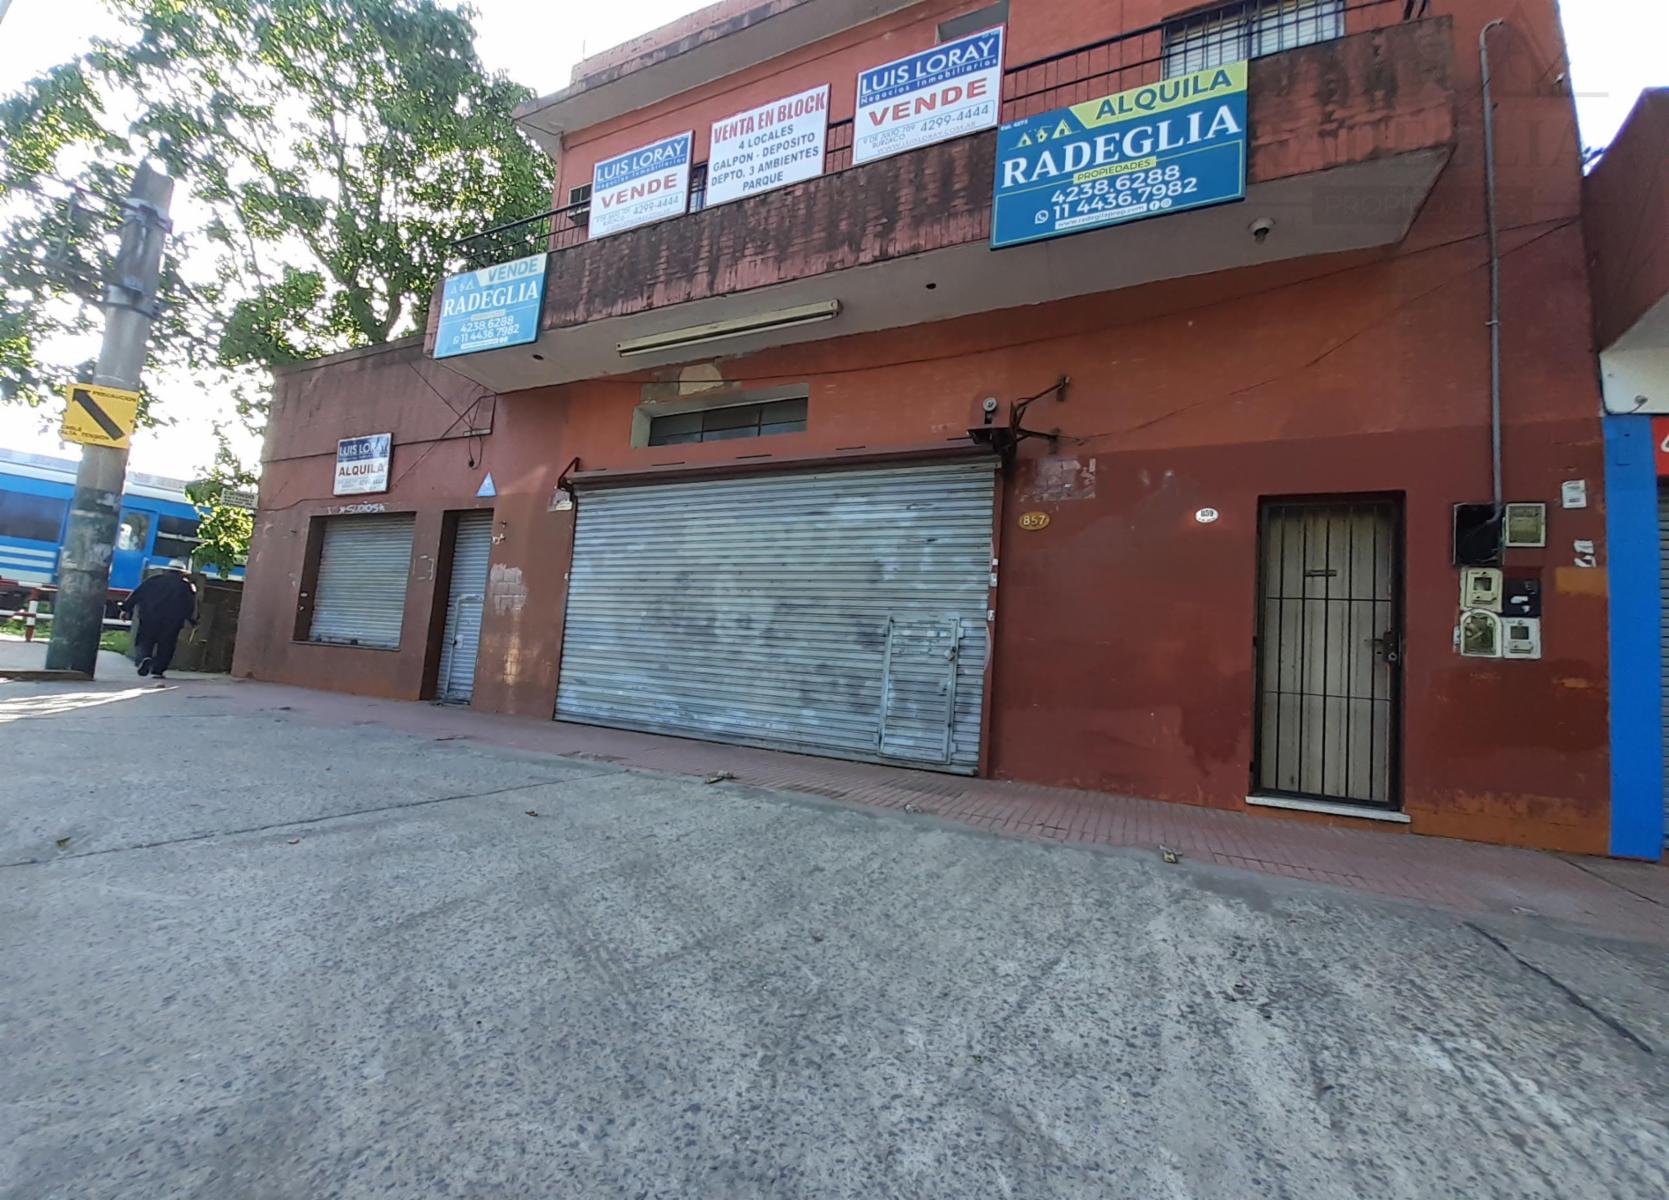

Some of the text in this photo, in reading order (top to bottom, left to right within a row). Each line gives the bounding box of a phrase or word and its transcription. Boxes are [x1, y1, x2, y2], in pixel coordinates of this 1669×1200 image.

[862, 38, 995, 94] LUIS LORAY
[860, 85, 910, 104] Negocios
[868, 77, 988, 127] VENDE
[1095, 69, 1233, 120] ALQUILA
[713, 91, 826, 144] VENTA EN BLOCK
[920, 105, 990, 131] 4299-4444
[713, 151, 754, 172] GALPON
[762, 132, 816, 158] DEPOSITO
[738, 124, 795, 149] 4 LOCALES
[1001, 104, 1242, 189] RADEGLIA
[597, 140, 685, 182] LUIS LORAY
[711, 146, 820, 186] DEPTO. 3 AMBIENTES
[1077, 159, 1151, 181] PROPIEDADES
[601, 173, 678, 209] VENDE
[742, 171, 785, 192] PARQUE
[1051, 165, 1181, 205] 4238.6288
[1054, 178, 1199, 220] 11 4436.7982
[488, 257, 539, 282] VENDE
[443, 280, 539, 317] RADEGLIA
[339, 444, 358, 456] LUIS
[338, 463, 384, 477] ALQUILA
[1023, 515, 1046, 526] 857
